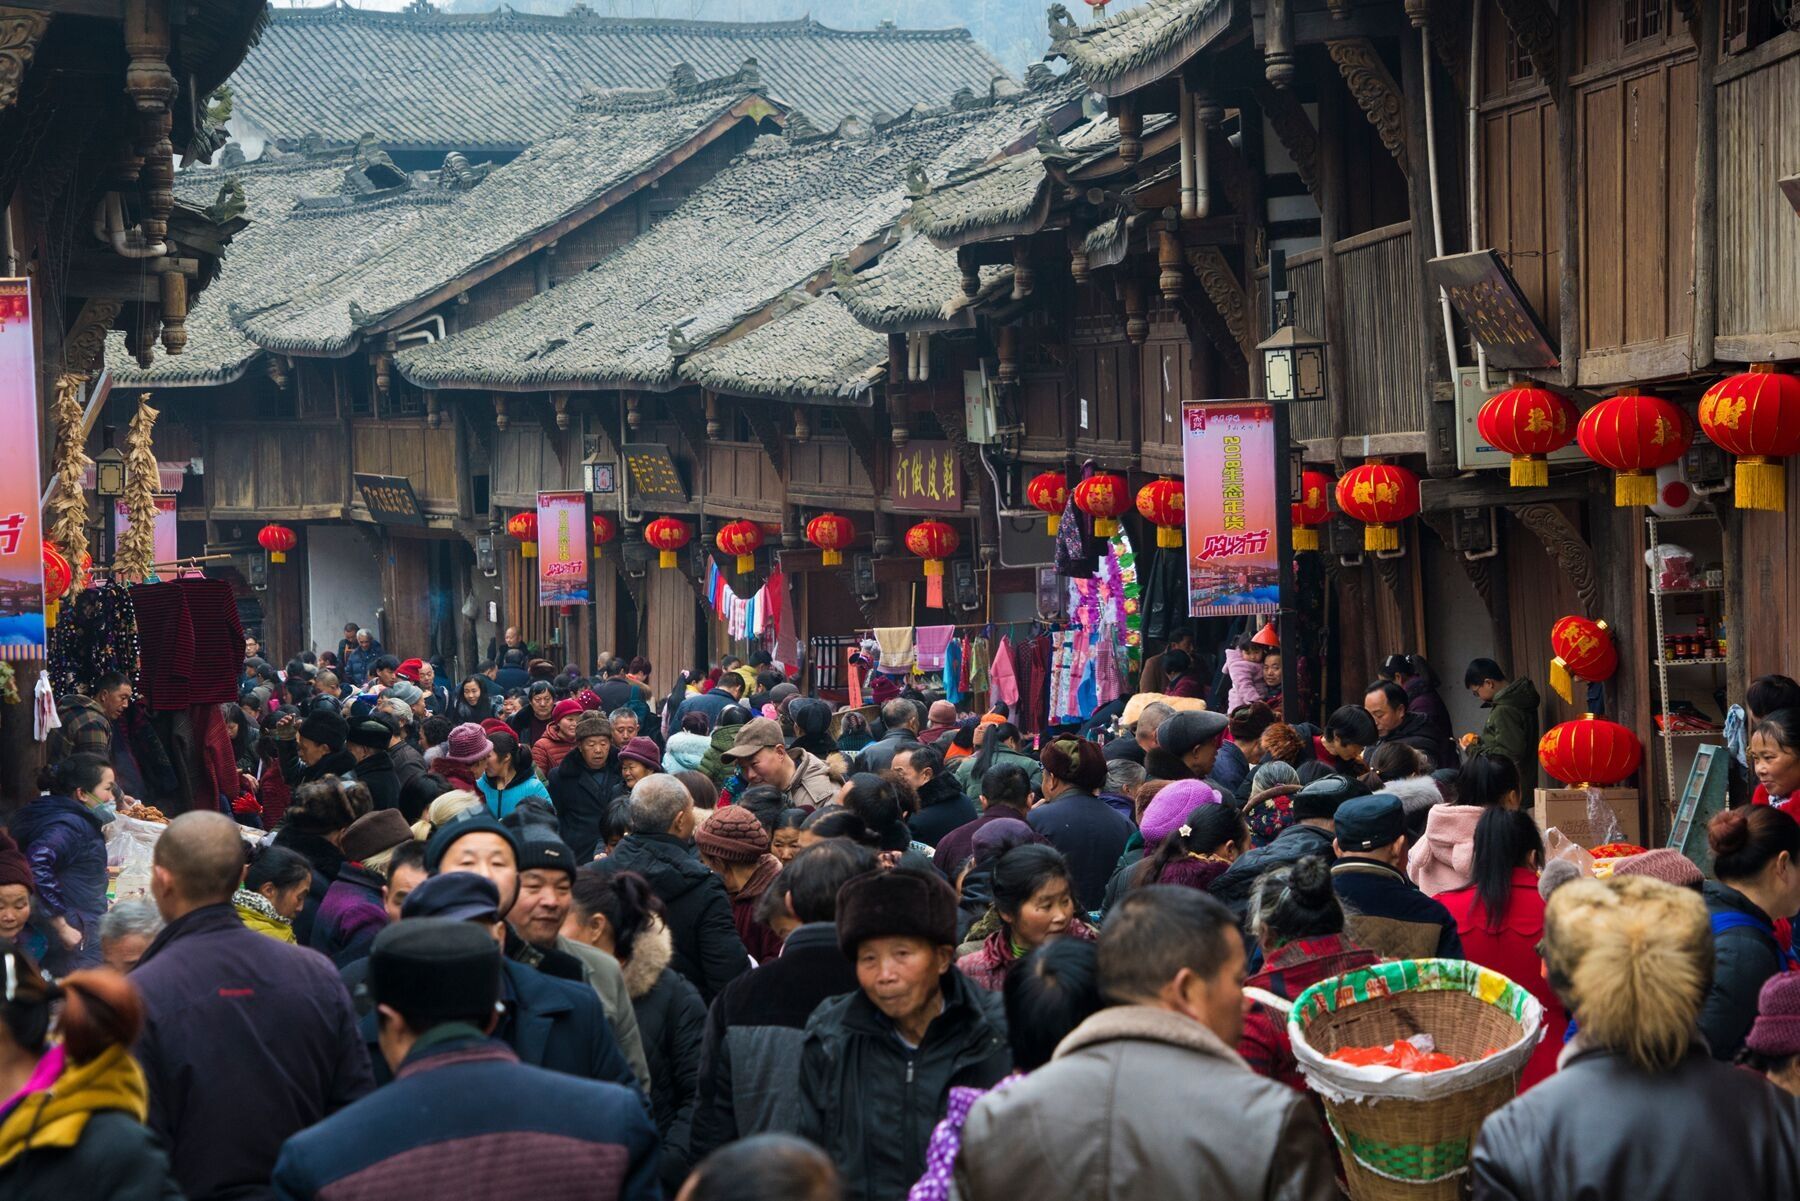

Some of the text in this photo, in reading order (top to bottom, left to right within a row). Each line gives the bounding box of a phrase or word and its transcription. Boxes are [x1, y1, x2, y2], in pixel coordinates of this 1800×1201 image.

[896, 448, 956, 502] 订做皮鞋
[1222, 435, 1246, 531] 2018生态年货
[1196, 528, 1271, 562] 购物节
